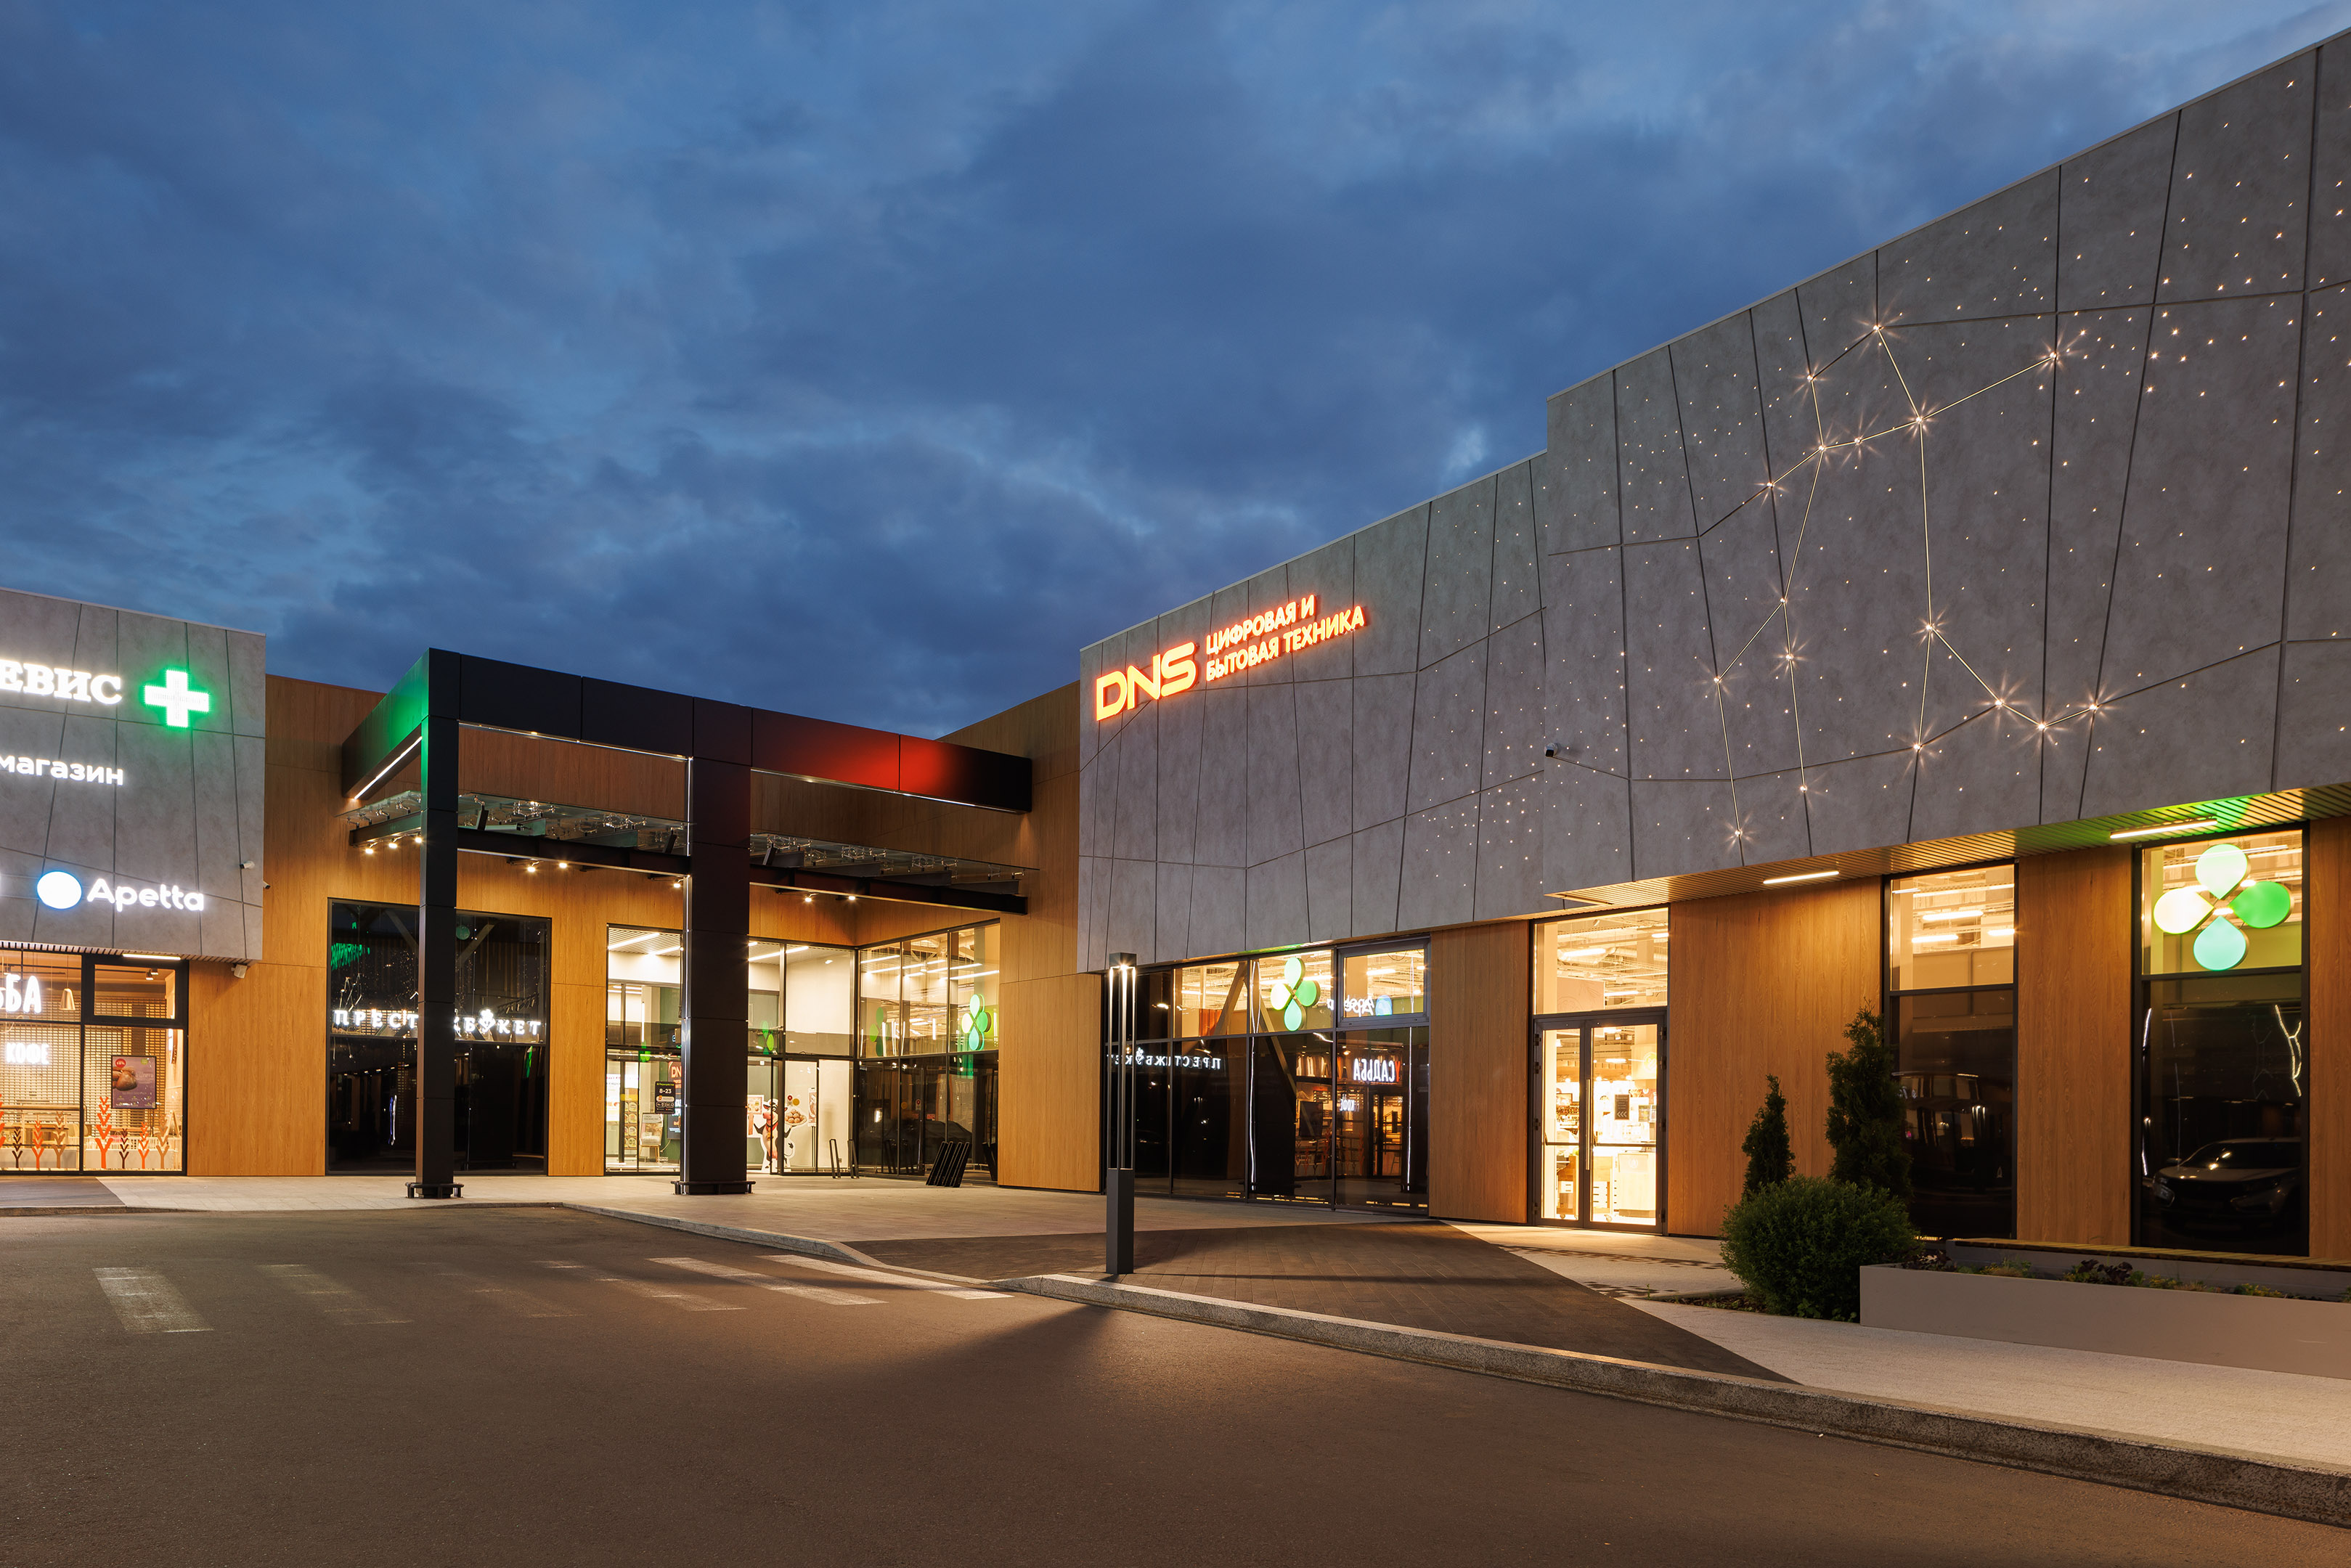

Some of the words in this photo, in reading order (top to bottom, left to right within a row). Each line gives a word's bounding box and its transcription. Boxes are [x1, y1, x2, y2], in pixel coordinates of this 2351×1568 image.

[1205, 601, 1297, 655] ЦИФРОВАЯ
[1300, 594, 1317, 619] И
[1205, 636, 1280, 682] БЫТОВАЯ
[1283, 605, 1366, 654] ТЕХНИКА
[1096, 641, 1198, 722] DNS
[0, 755, 123, 786] магазин
[86, 878, 204, 912] Apetta
[0, 973, 41, 1013] БА
[6, 1042, 50, 1065] КОФЕ
[671, 1066, 682, 1078] DN
